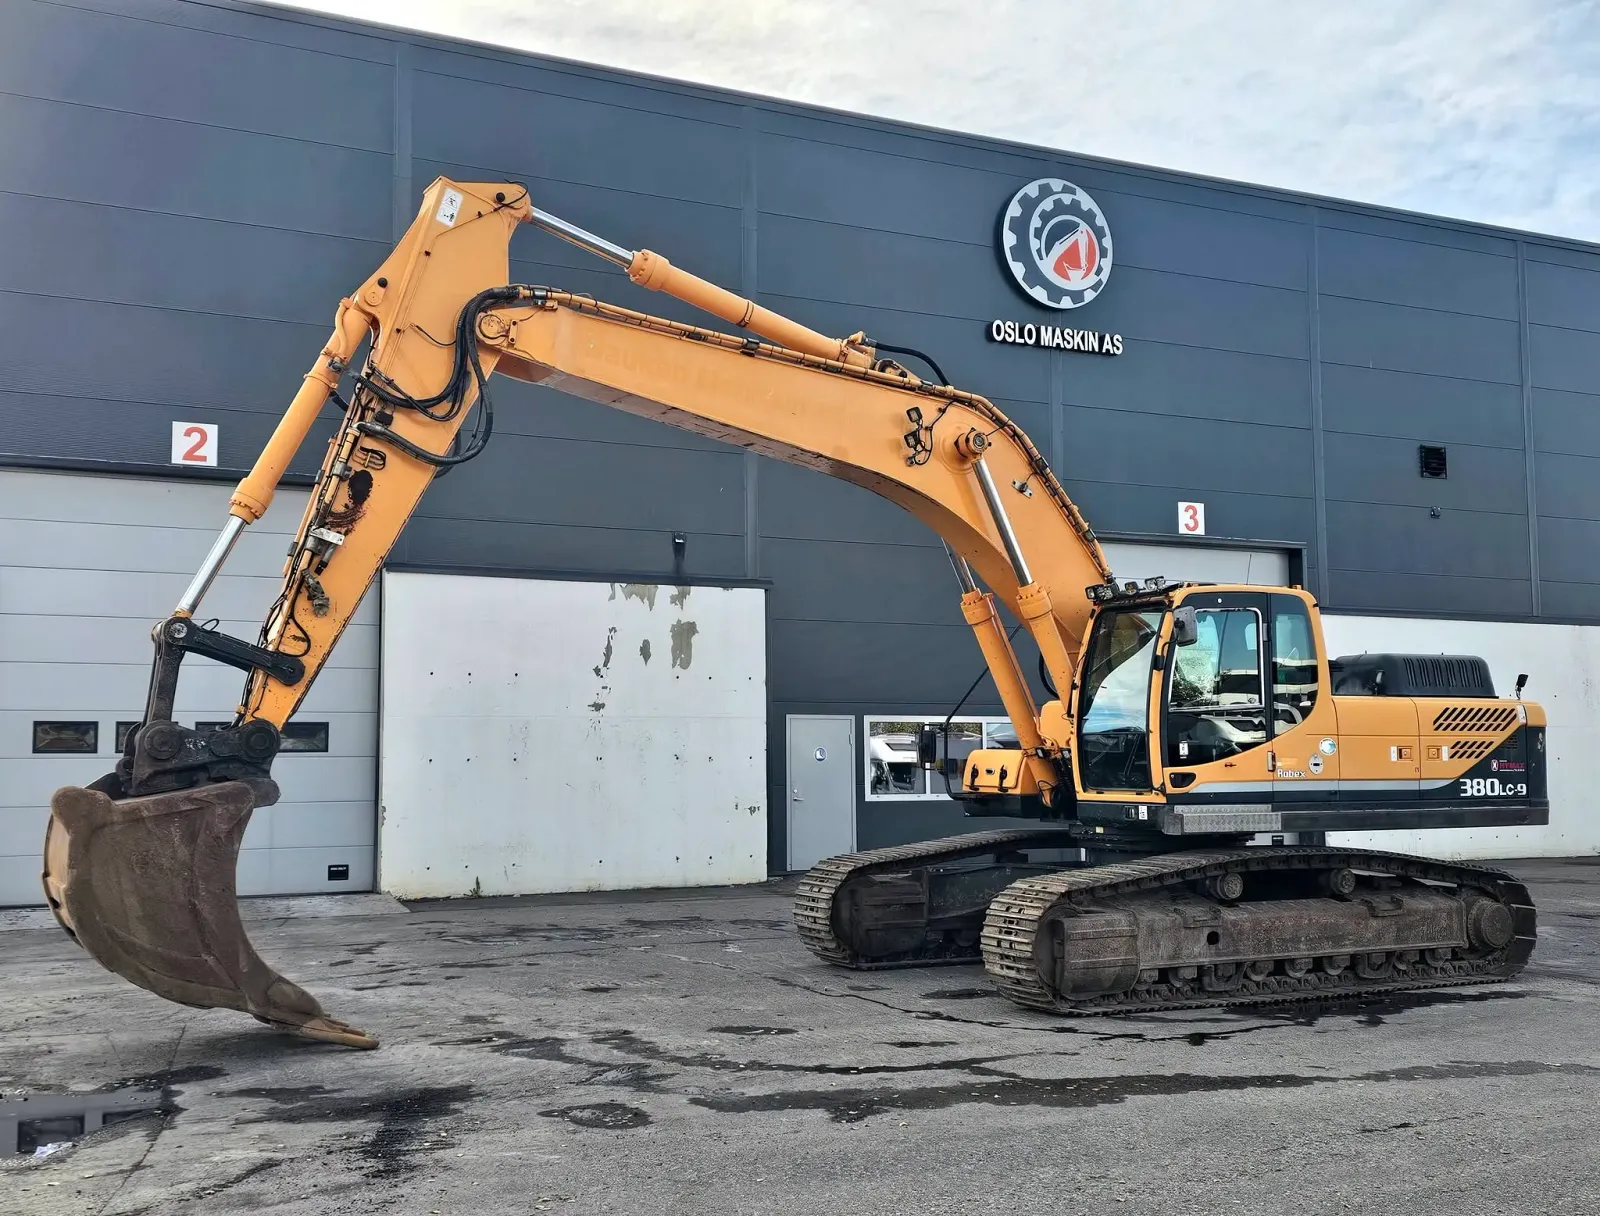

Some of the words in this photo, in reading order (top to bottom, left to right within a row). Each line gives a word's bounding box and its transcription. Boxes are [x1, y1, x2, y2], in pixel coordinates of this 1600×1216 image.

[992, 319, 1036, 345] OSLO
[1040, 325, 1099, 352] MASKIN
[1102, 333, 1124, 355] AS
[182, 426, 208, 462] 2
[1184, 504, 1199, 532] 3
[1277, 769, 1306, 778] Robex
